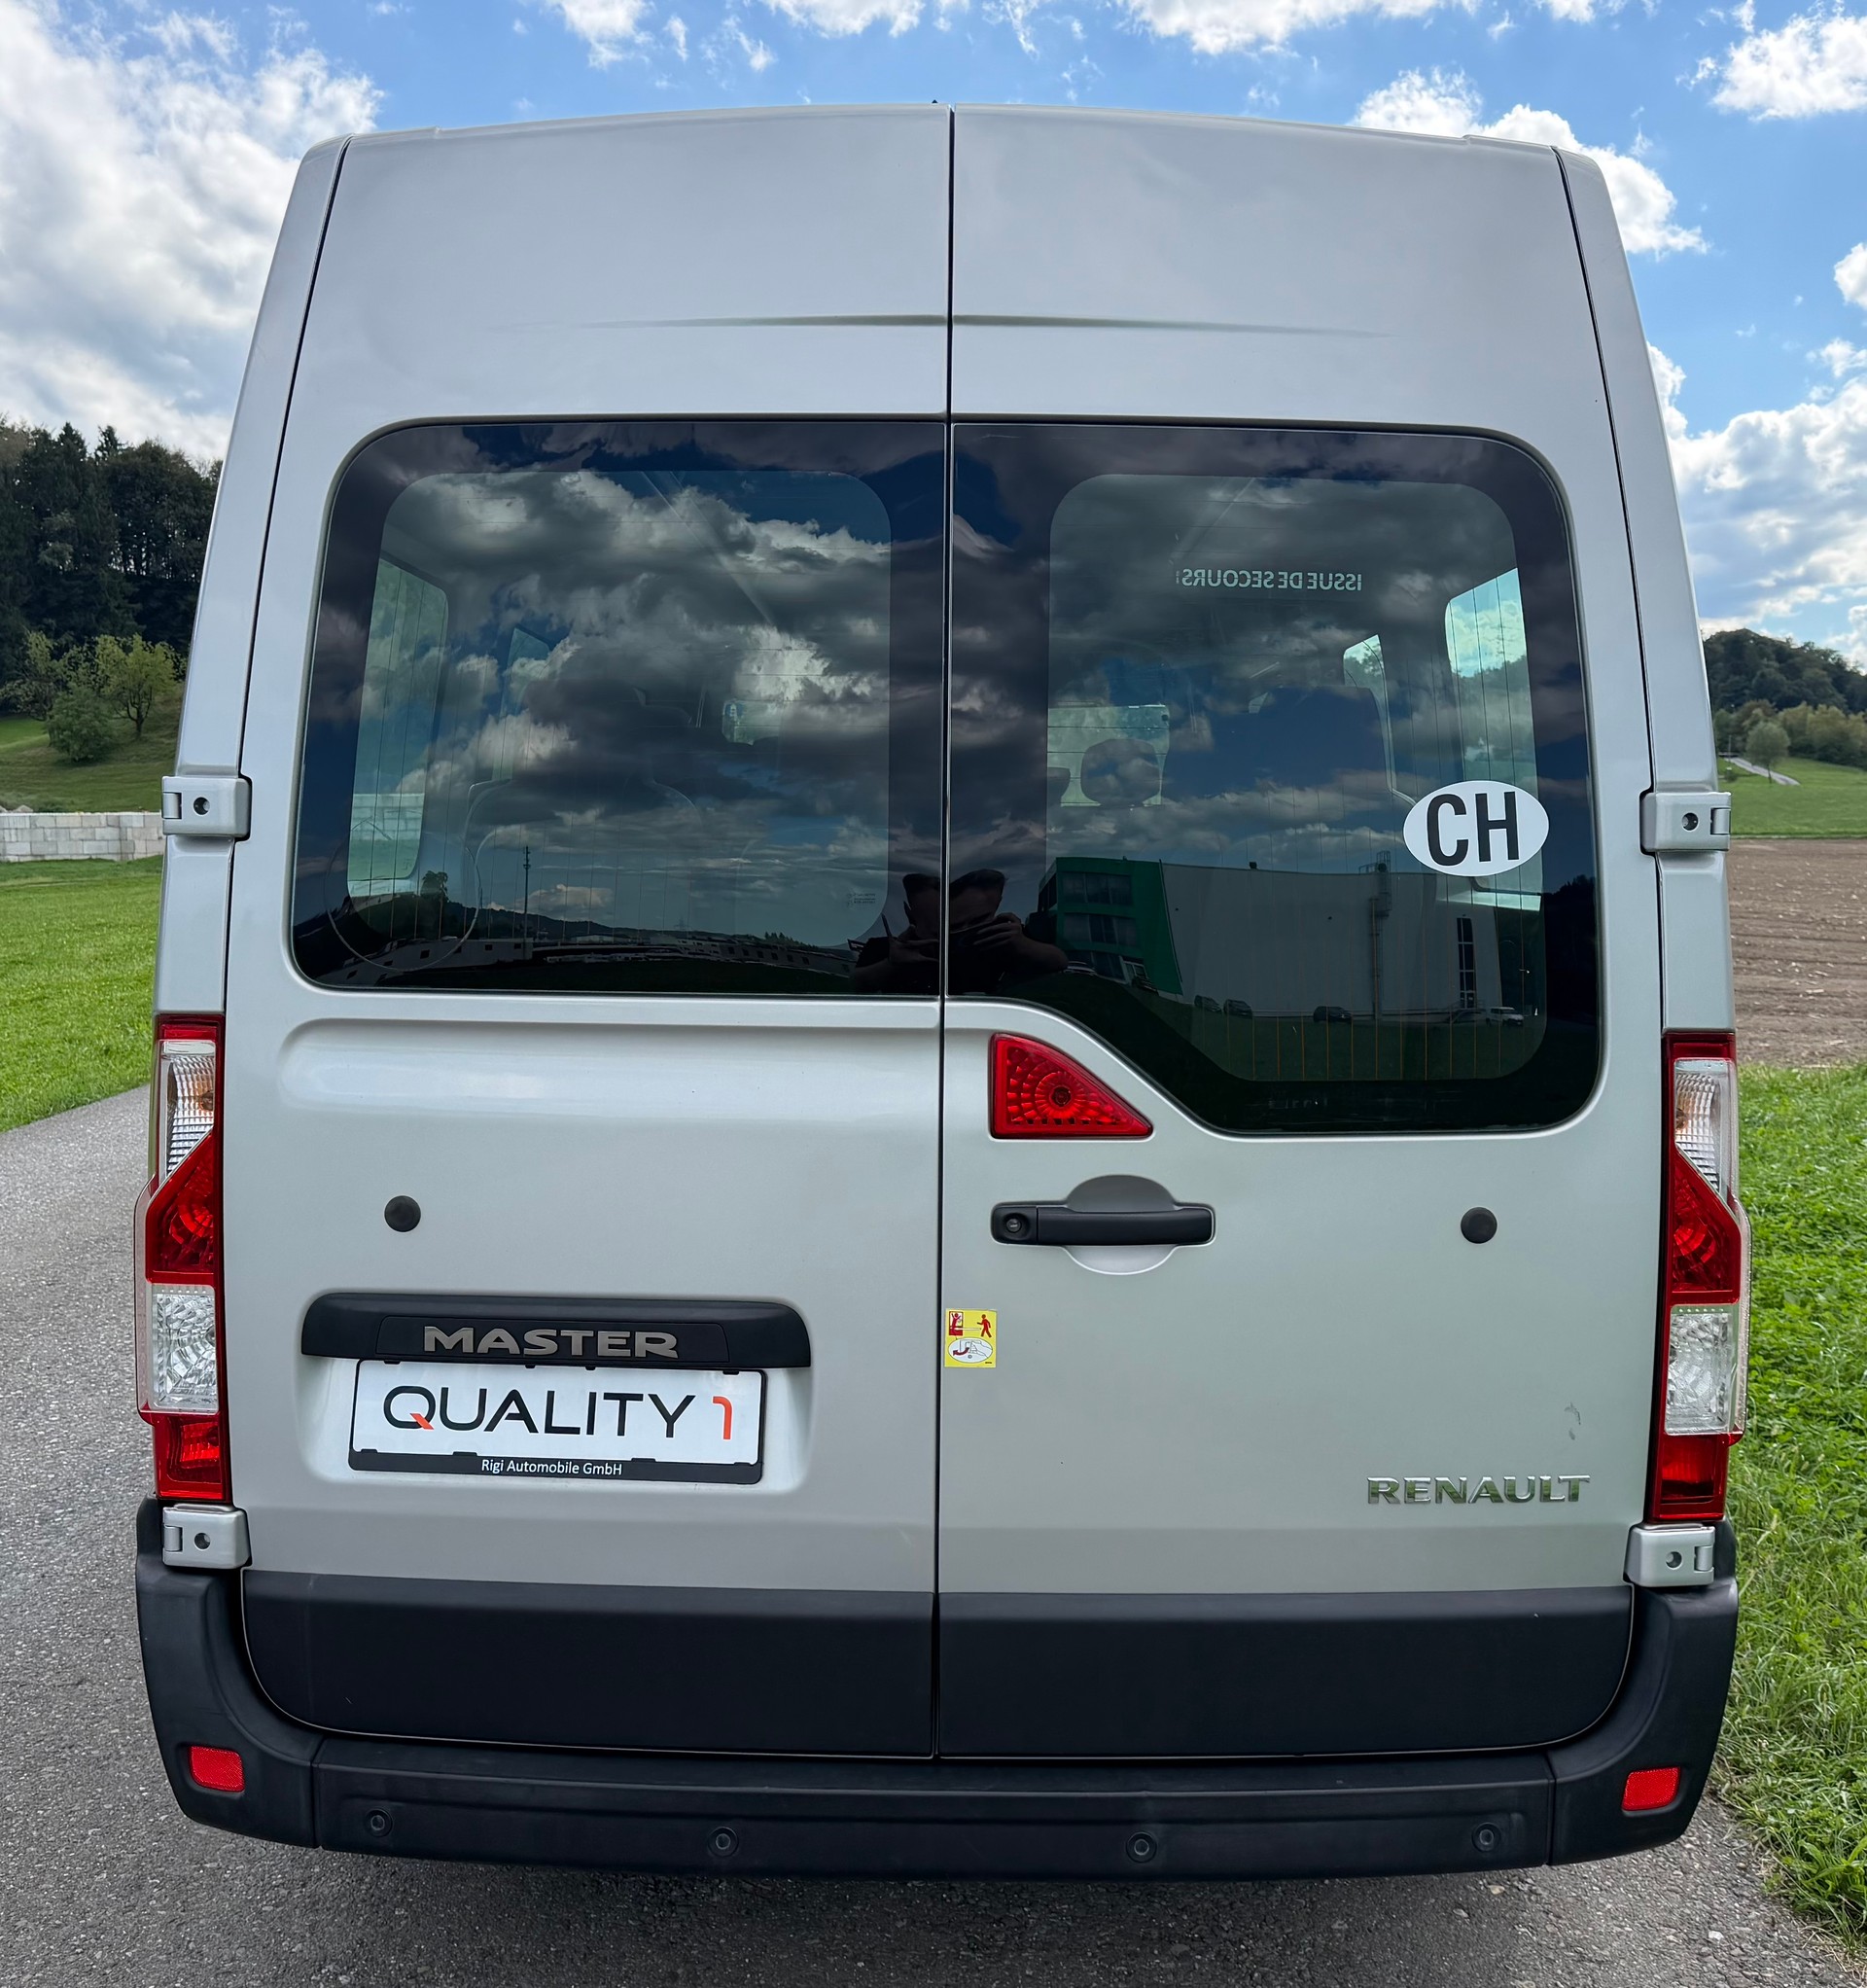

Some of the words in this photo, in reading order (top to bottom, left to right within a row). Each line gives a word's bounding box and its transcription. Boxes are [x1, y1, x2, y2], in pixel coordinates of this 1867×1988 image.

[1427, 791, 1520, 867] CH
[423, 1326, 680, 1359] MASTER
[382, 1385, 696, 1439] QUALITY
[712, 1396, 734, 1440] 1
[481, 1459, 504, 1474] Rigi
[506, 1460, 580, 1474] Automobile
[582, 1462, 622, 1475] GmbH
[1366, 1474, 1591, 1505] RENAULT
